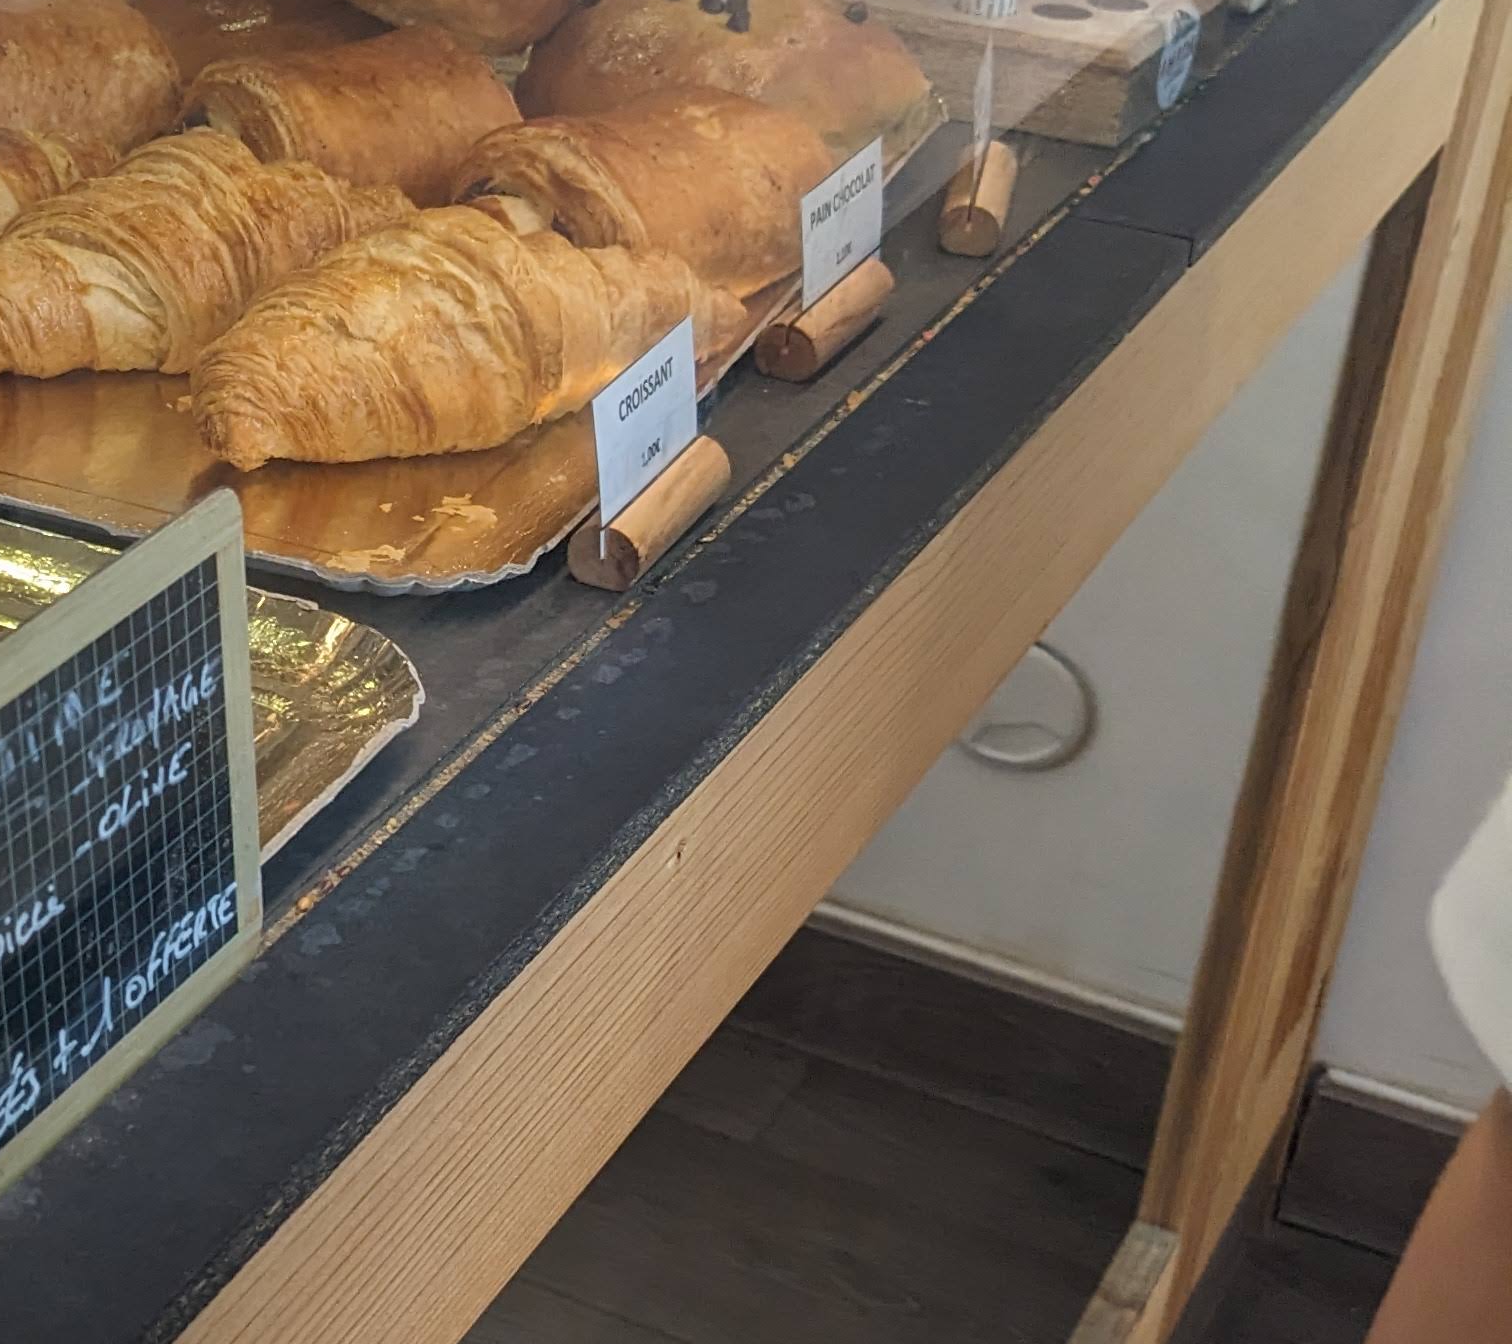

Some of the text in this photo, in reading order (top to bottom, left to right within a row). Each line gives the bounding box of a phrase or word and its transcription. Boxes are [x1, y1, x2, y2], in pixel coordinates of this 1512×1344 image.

[809, 163, 876, 232] PAIN CHOCOLAT
[618, 356, 673, 423] CROISSANT
[124, 882, 238, 1010] OFFERTE
